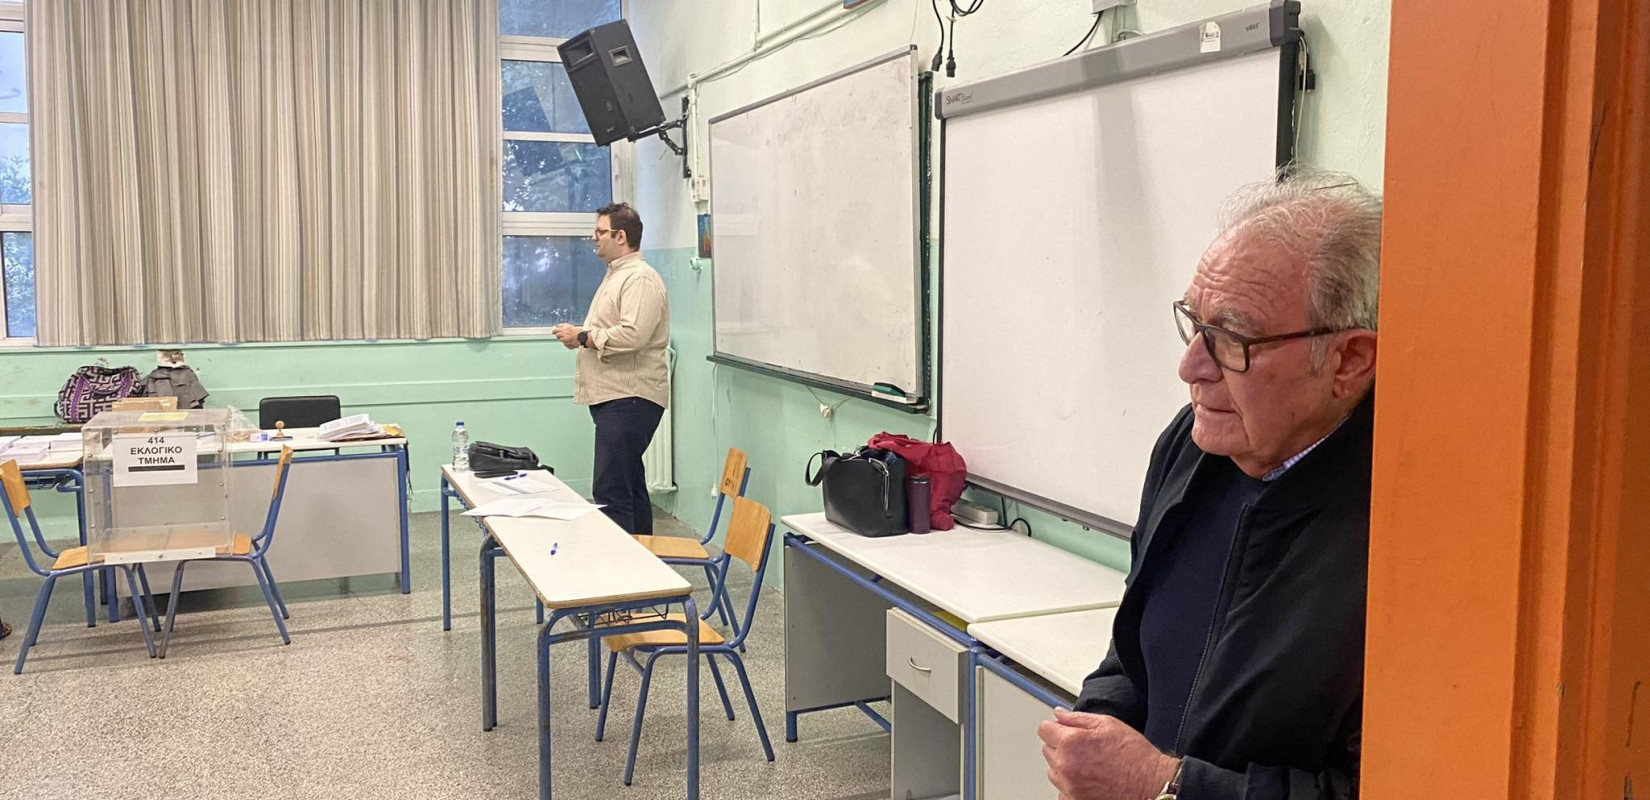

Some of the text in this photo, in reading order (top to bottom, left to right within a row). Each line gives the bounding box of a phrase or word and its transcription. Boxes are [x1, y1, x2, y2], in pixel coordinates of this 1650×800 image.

[147, 436, 165, 444] 414
[130, 446, 183, 455] ΕΚΛΟΓΙΚΟ
[138, 456, 176, 465] ΤΜΗΜΑ
